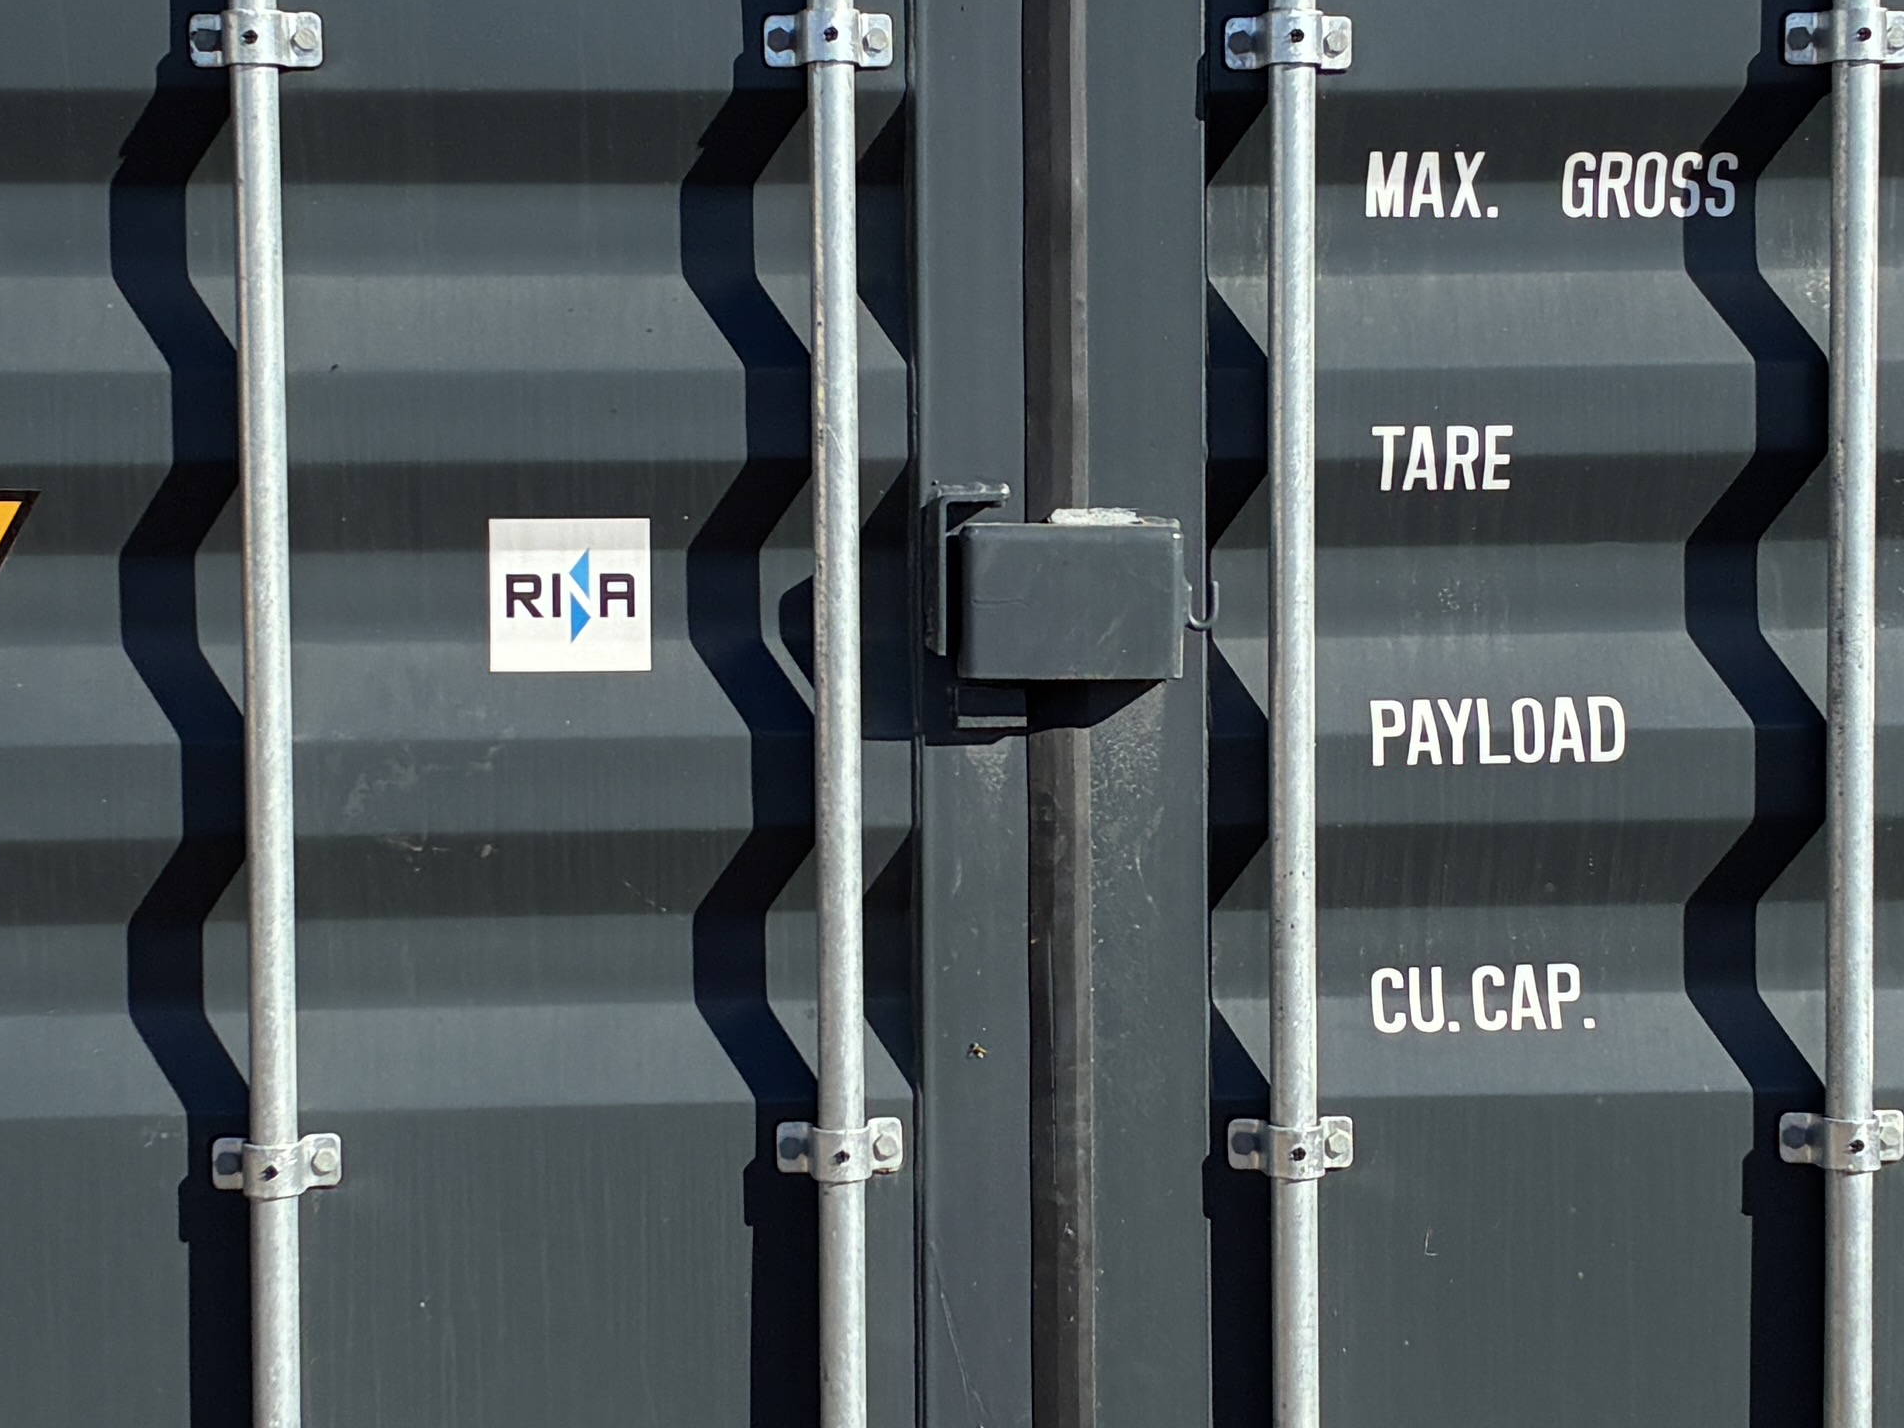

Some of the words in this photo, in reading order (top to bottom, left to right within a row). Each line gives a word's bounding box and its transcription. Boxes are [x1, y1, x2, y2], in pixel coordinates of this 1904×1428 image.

[1365, 151, 1499, 219] MAX.
[1561, 151, 1739, 219] GROSS
[1371, 424, 1514, 491] TARE
[1369, 695, 1626, 767] PAYLOAD
[1370, 966, 1461, 1034] CU.
[1471, 962, 1596, 1032] CAP.
